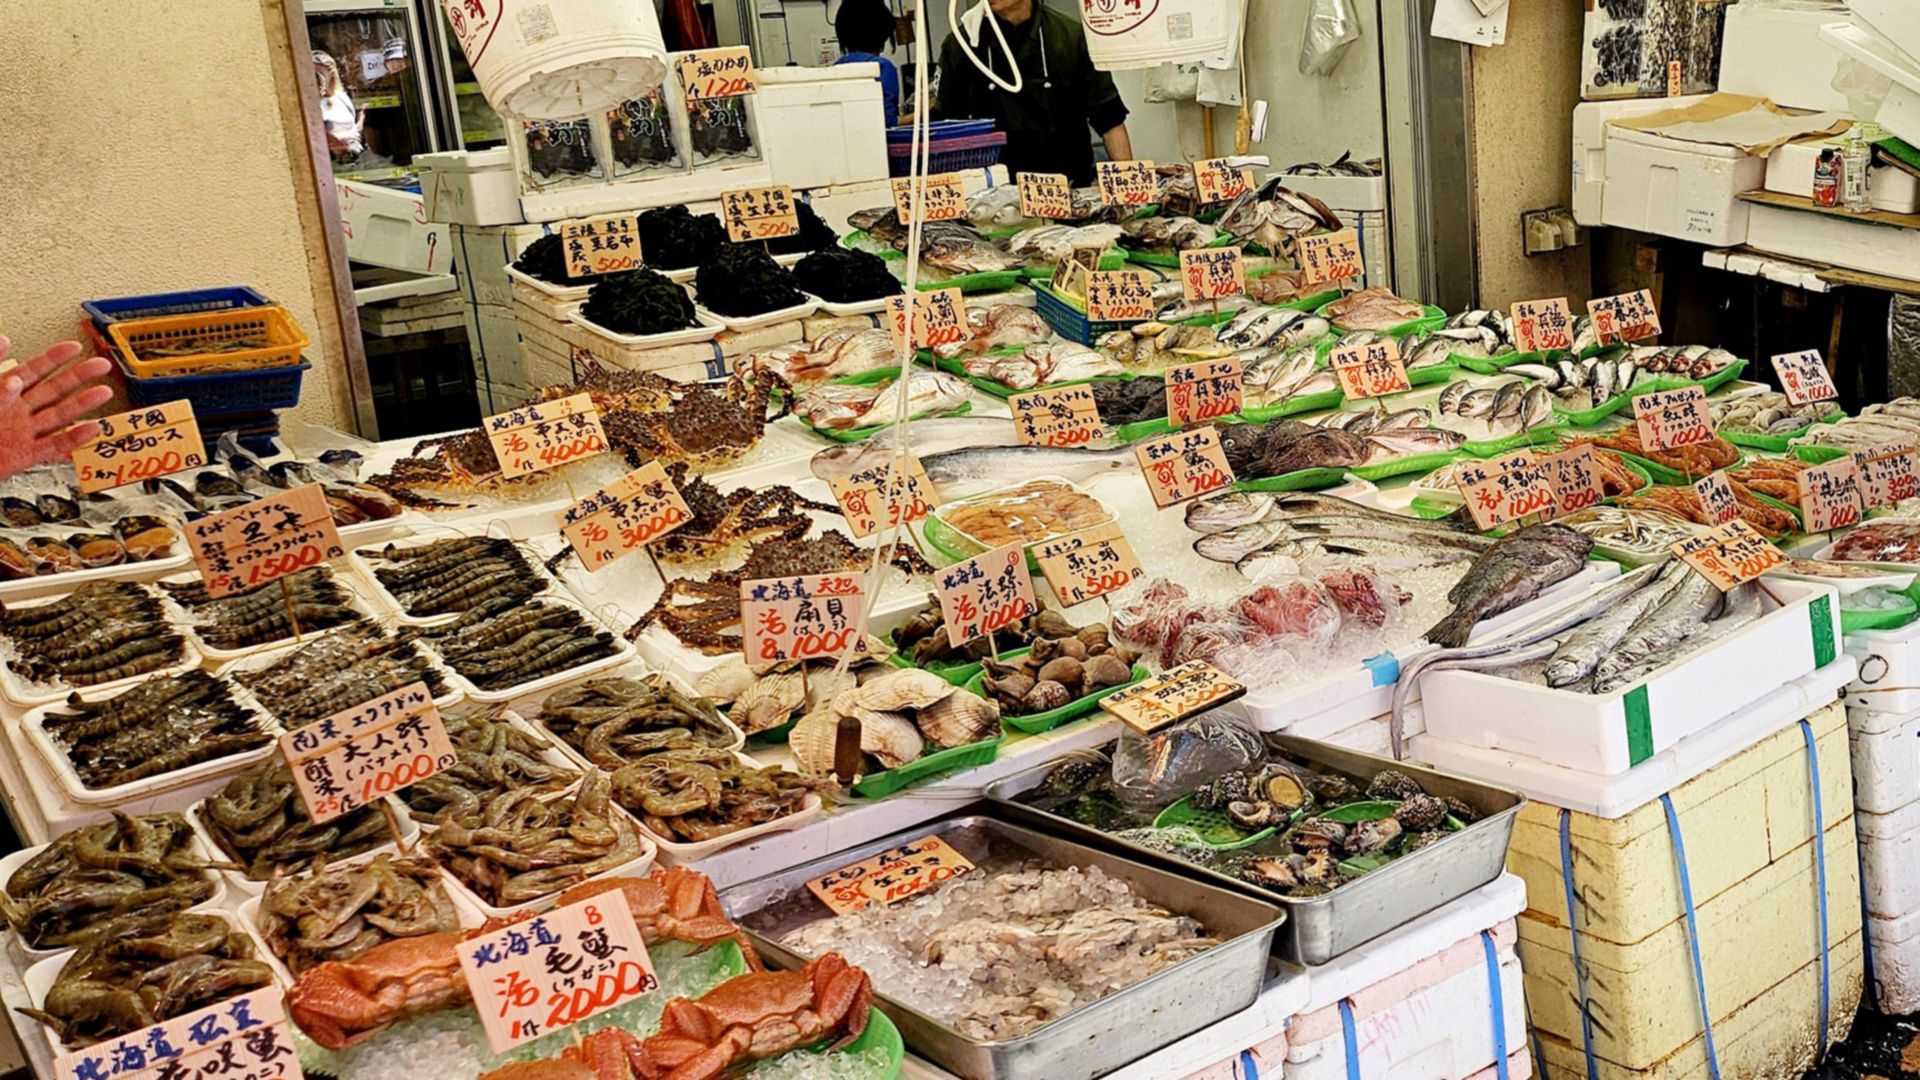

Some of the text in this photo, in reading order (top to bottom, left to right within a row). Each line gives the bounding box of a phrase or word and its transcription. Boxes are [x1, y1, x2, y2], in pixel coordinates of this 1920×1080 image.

[706, 78, 756, 97] 1200円
[756, 222, 800, 238] 500円
[597, 256, 644, 272] 500円
[1329, 263, 1360, 278] 800円
[1211, 281, 1243, 296] 700円
[1109, 306, 1153, 319] 1000円
[1371, 376, 1409, 393] 500円
[1053, 391, 1092, 403] ベトナム
[1665, 391, 1703, 404] アルゼンチン
[492, 407, 543, 431] 北海道
[94, 428, 183, 460] 合鴨ロース
[539, 435, 608, 464] 4000円
[1048, 428, 1103, 449] 1500円
[1187, 471, 1233, 492] 700円
[1888, 474, 1919, 491] 300円
[564, 494, 617, 523] 北海道
[1562, 489, 1604, 512] 500円
[621, 507, 691, 548] 3000円
[943, 561, 984, 590] 北海道
[1735, 550, 1788, 577] 2000円
[751, 575, 858, 600] 北海道 天然
[1086, 567, 1144, 595] 500円
[290, 691, 425, 752] 南米 エクアドル
[470, 906, 603, 969] 北海道 8
[544, 928, 628, 977] 毛蟹
[545, 961, 659, 1028] 2000円
[72, 1027, 184, 1080] 北海道
